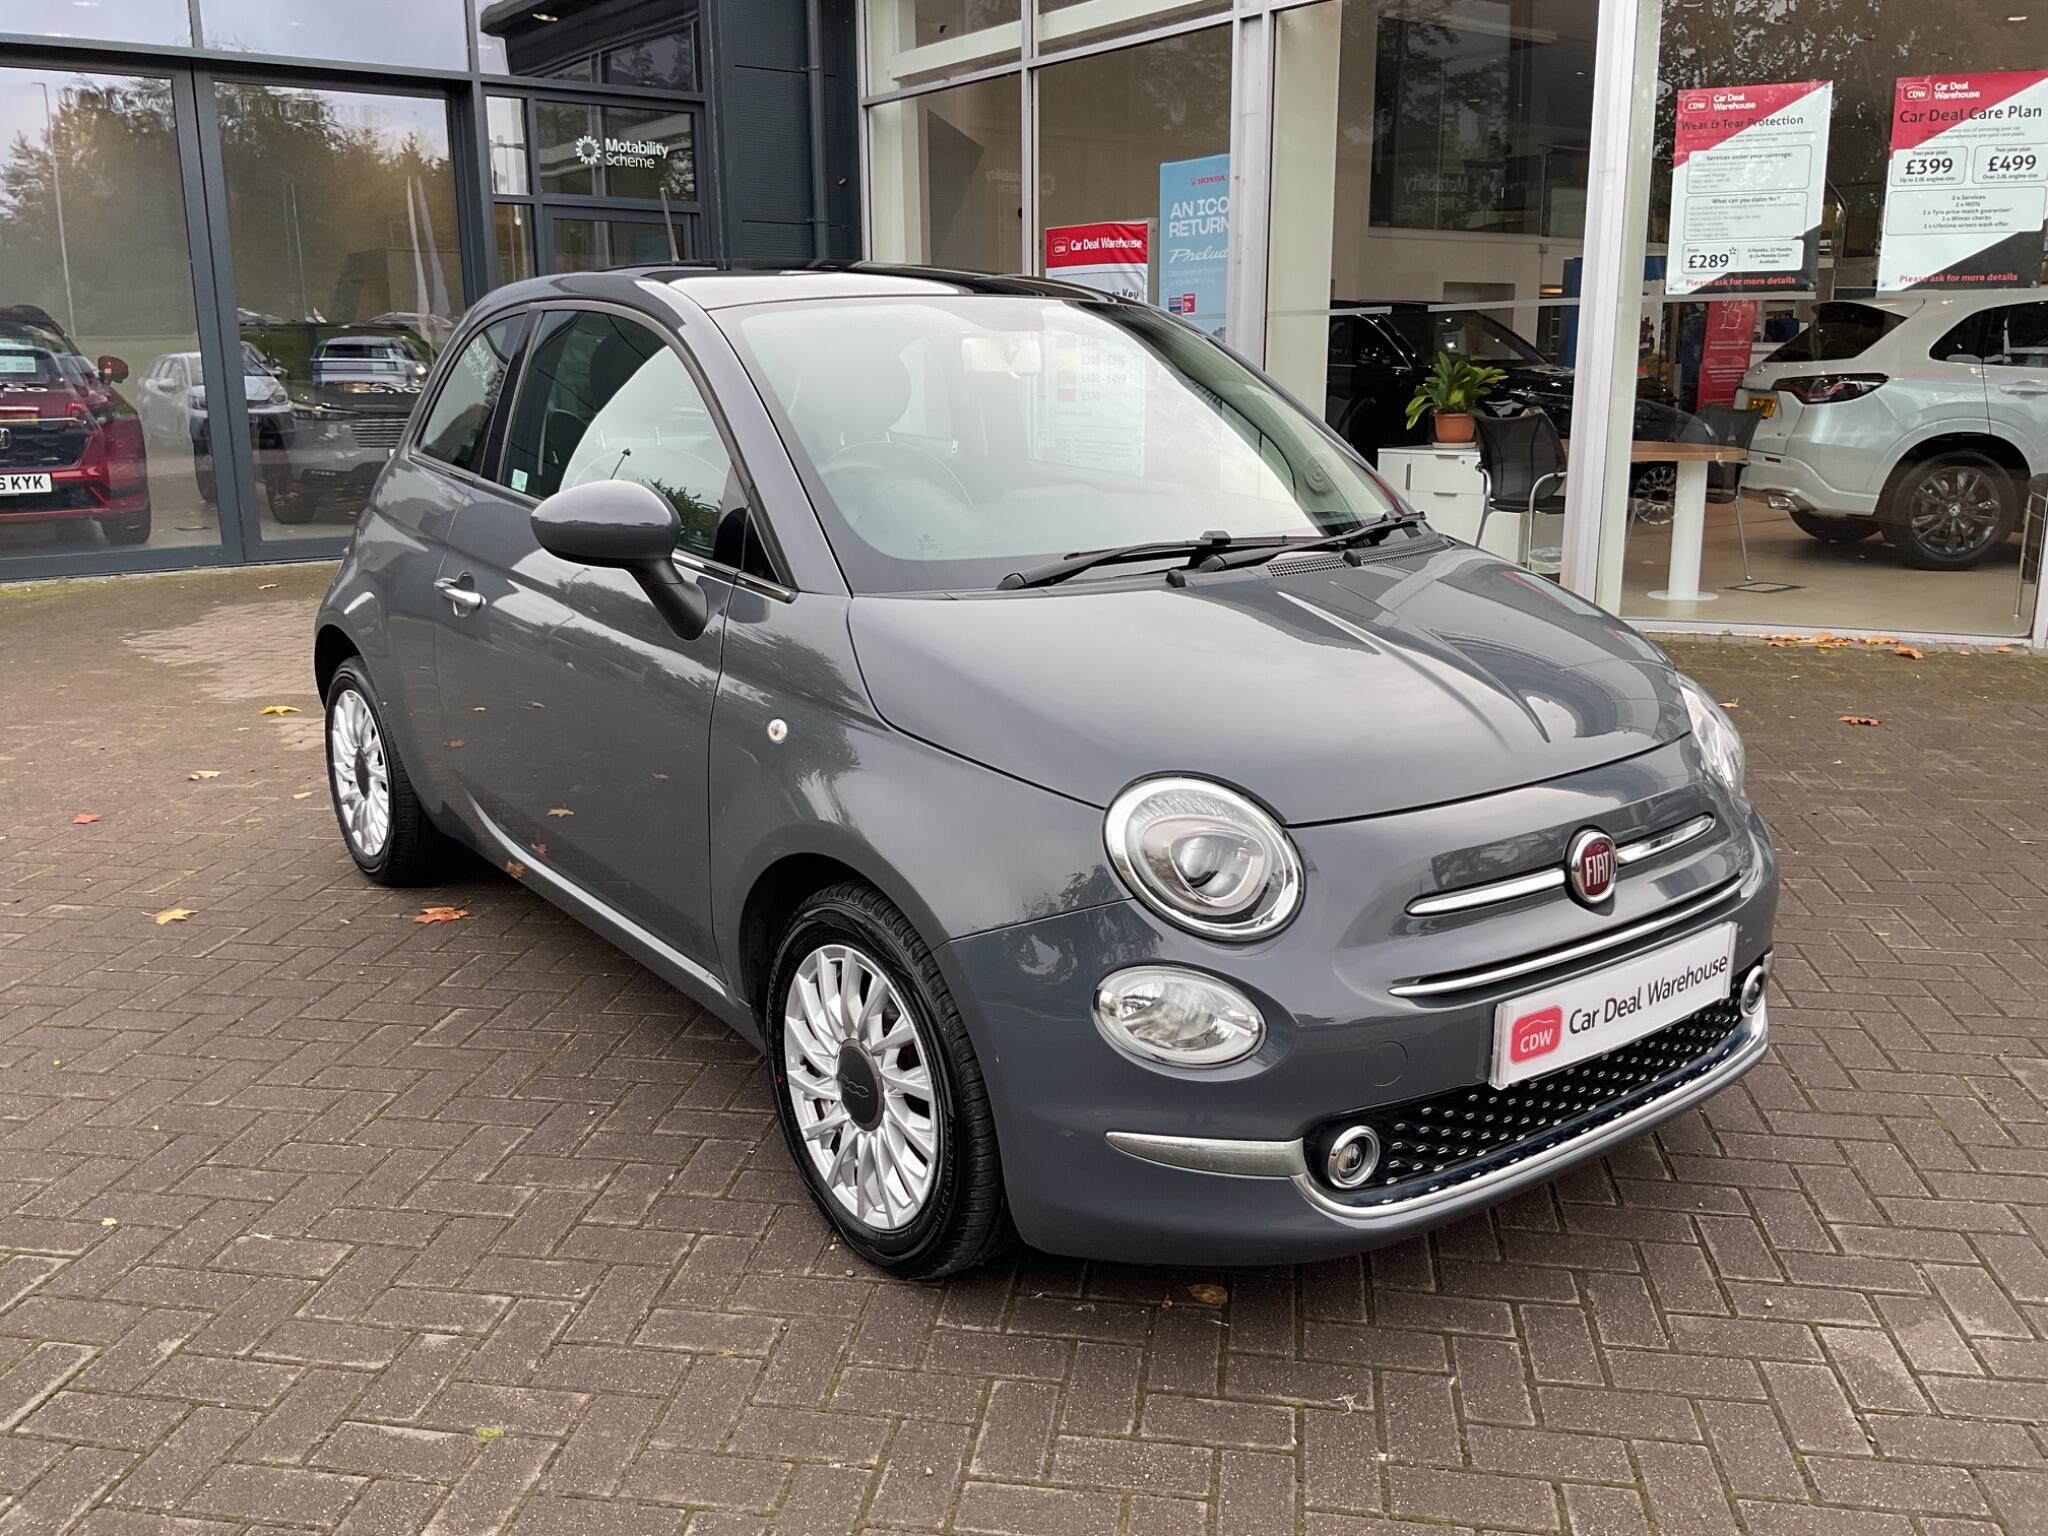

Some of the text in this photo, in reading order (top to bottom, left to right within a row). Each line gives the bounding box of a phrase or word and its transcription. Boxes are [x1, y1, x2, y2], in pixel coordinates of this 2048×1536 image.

[1935, 81, 1969, 91] Car Deal
[1713, 92, 1745, 102] Car Deal
[1907, 90, 1926, 98] CDW
[1934, 90, 1980, 100] Warehouse
[1713, 101, 1757, 111] Warehouse
[1900, 105, 2042, 123] Car Deal Care Plan
[1682, 115, 1803, 131] Wear & Tear Protection
[605, 138, 669, 159] Motability
[606, 152, 655, 169] Scheme
[1905, 157, 1953, 175] £399
[1988, 154, 2037, 172] £499
[1198, 175, 1226, 185] HONDA
[1170, 195, 1230, 219] AN ICO
[1070, 239, 1083, 251] Car
[1083, 237, 1100, 251] Deal
[1100, 236, 1143, 249] Warehouse
[1688, 253, 1729, 269] £289
[1686, 276, 1796, 287] Please ask for more details
[1899, 274, 1928, 283] Please
[1930, 274, 1945, 282] ask
[1946, 273, 1960, 282] for
[1986, 272, 2018, 281] details
[11, 475, 44, 490] KYK
[1585, 851, 1610, 888] FIAT
[1519, 954, 1728, 1053] CDW Car Deal Warehouse
